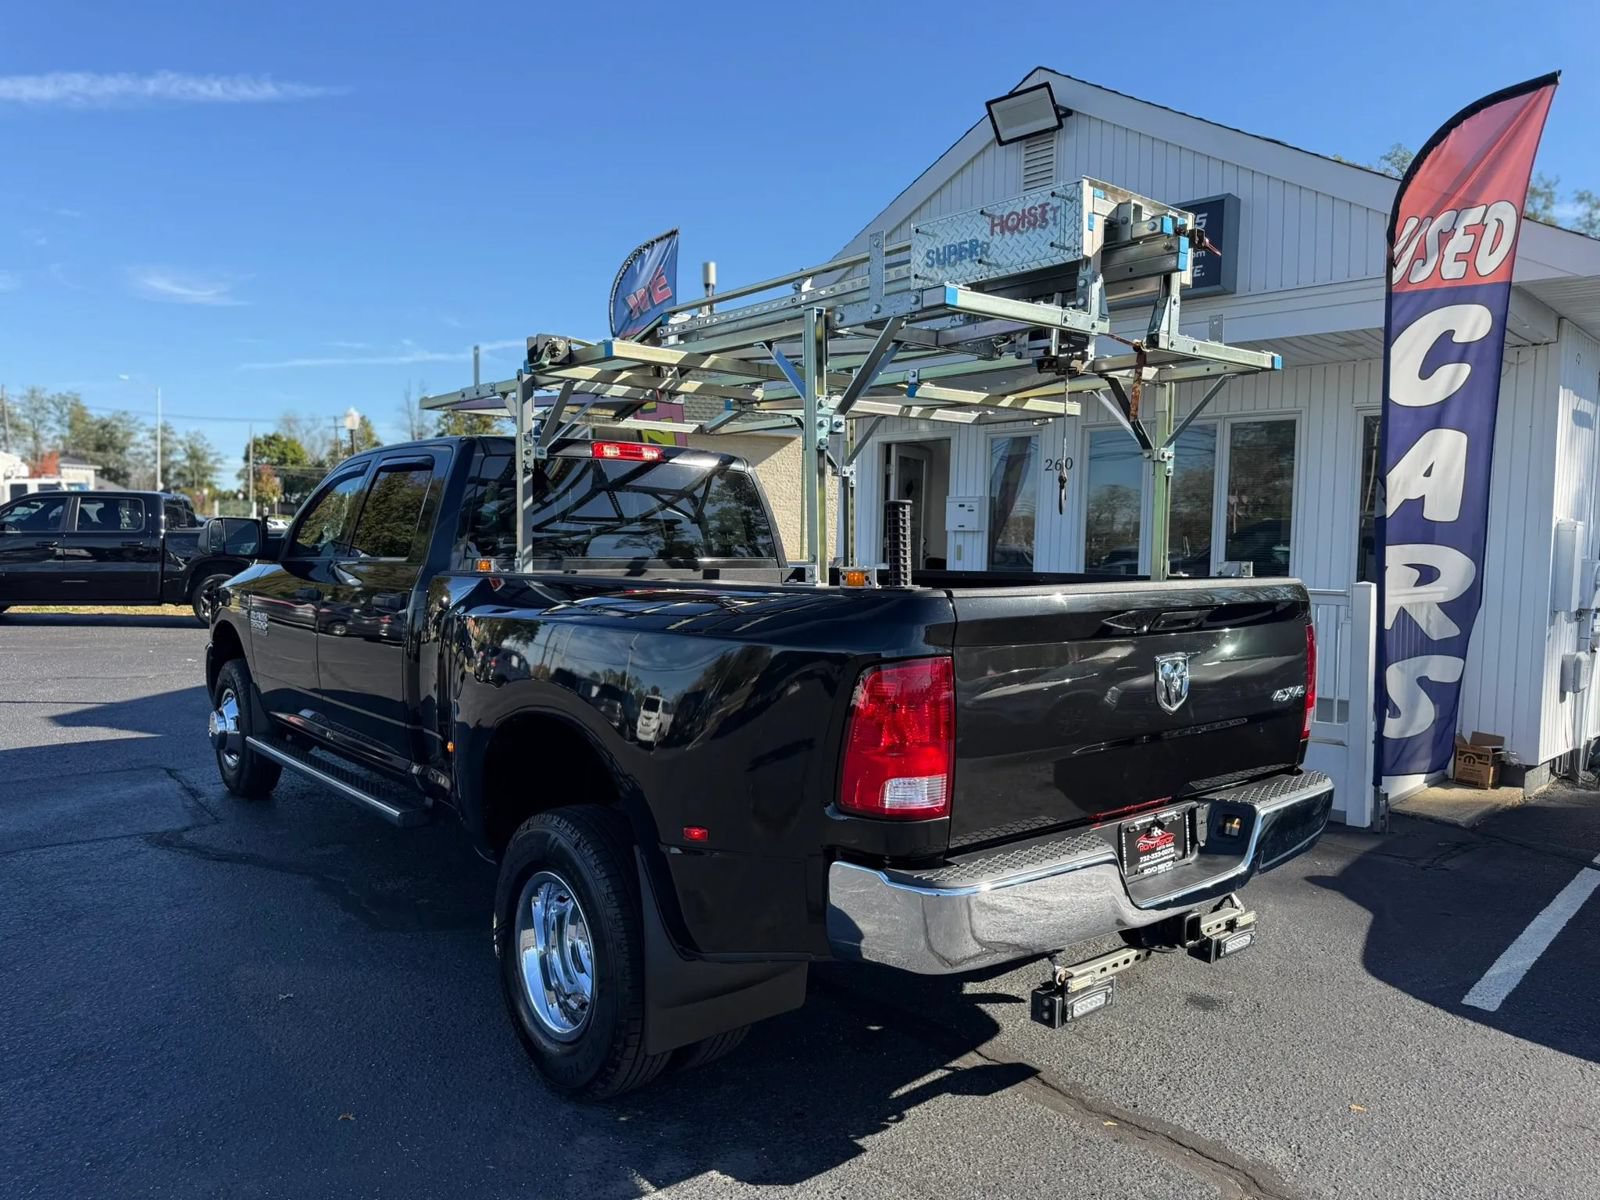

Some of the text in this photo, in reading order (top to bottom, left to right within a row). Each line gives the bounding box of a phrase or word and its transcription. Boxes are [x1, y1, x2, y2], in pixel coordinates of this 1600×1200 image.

[990, 202, 1053, 236] HOIST
[925, 238, 983, 268] SUPER
[1392, 200, 1518, 286] USED
[1045, 457, 1073, 471] 260
[1382, 303, 1493, 739] CARS
